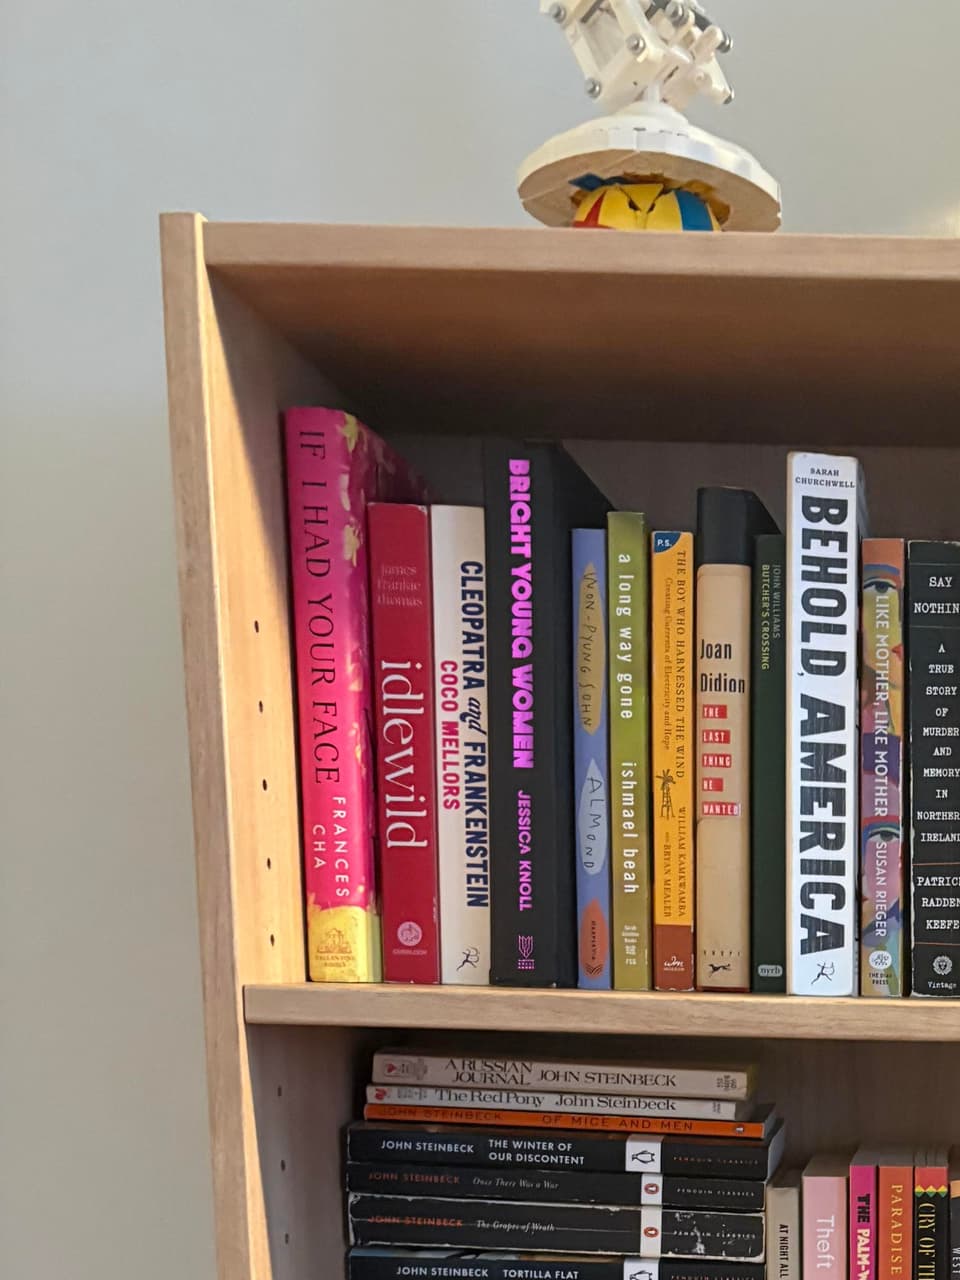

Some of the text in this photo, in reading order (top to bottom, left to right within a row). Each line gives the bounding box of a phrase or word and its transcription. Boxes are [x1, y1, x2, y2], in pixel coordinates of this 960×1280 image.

[795, 468, 855, 488] SARAH CHURCHWELL
[300, 431, 340, 784] IF I HAD YOUR FACE
[509, 459, 534, 768] BRIGHT YOUNG WOMEN
[616, 554, 634, 719] a long way gone
[761, 565, 770, 669] BUTCHER'S CROSSING
[929, 576, 952, 588] SAY
[675, 551, 686, 778] THE BOY WHO HARNESSED THE WIND
[700, 639, 745, 693] Joan Didion
[381, 660, 428, 849] idlewild
[440, 660, 460, 810] COCO MELLORS
[460, 561, 489, 907] CLEOPATRA and FRANKENSTEIN
[622, 762, 639, 893] ishmael beah
[799, 692, 847, 956] AMERICA
[381, 1140, 474, 1153] JOHN STEINBECK
[489, 1140, 572, 1151] THE WINTER OF
[489, 1153, 584, 1164] OUR DISCONTENT
[816, 1216, 835, 1269] Theft
